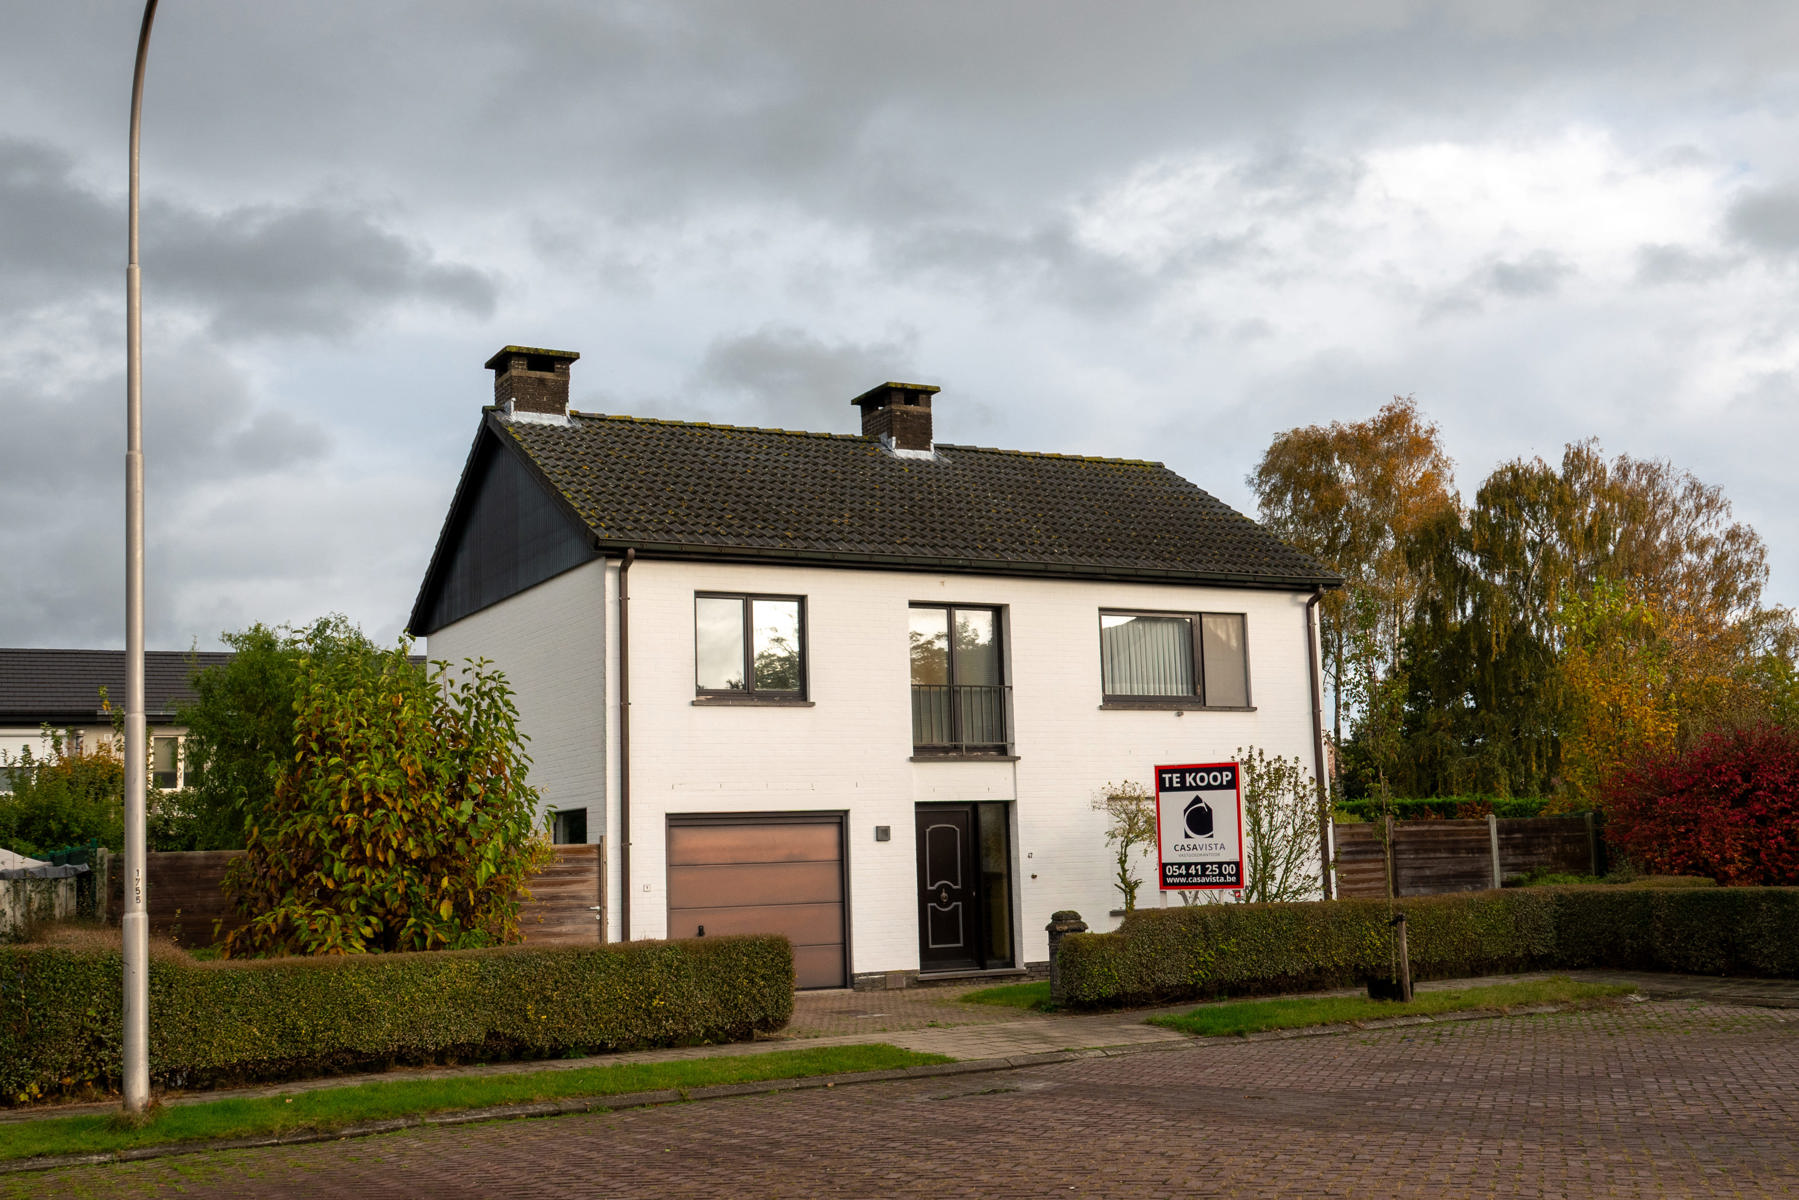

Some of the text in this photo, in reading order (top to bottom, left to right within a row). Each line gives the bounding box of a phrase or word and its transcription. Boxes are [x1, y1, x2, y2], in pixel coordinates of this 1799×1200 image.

[1162, 771, 1232, 788] TE KOOP
[1173, 843, 1226, 852] CASAVISTA
[1166, 864, 1236, 875] 054 41 25 00
[1166, 875, 1236, 883] www.casavista.be
